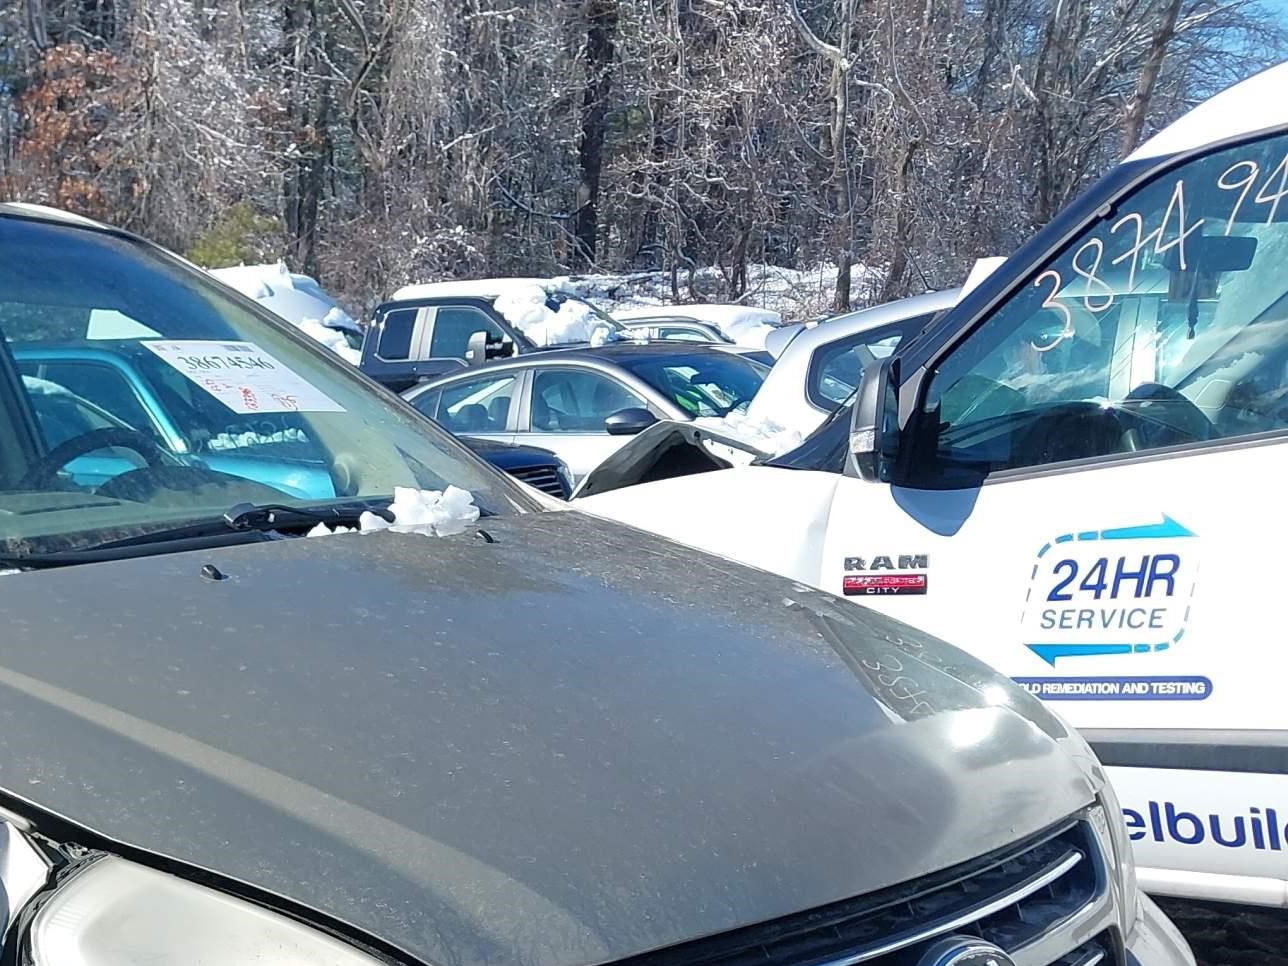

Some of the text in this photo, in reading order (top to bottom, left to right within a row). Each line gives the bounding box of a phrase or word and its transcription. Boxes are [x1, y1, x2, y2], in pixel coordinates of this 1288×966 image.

[177, 355, 276, 371] 38674546
[844, 554, 929, 571] RAM
[1046, 553, 1181, 602] 24HR
[866, 586, 900, 594] CITY
[1040, 608, 1167, 630] SERVICE
[1042, 682, 1121, 695] REMEDIATION
[1122, 682, 1149, 694] AND
[1150, 682, 1206, 695] TESTING
[1122, 800, 1288, 851] elbuil
